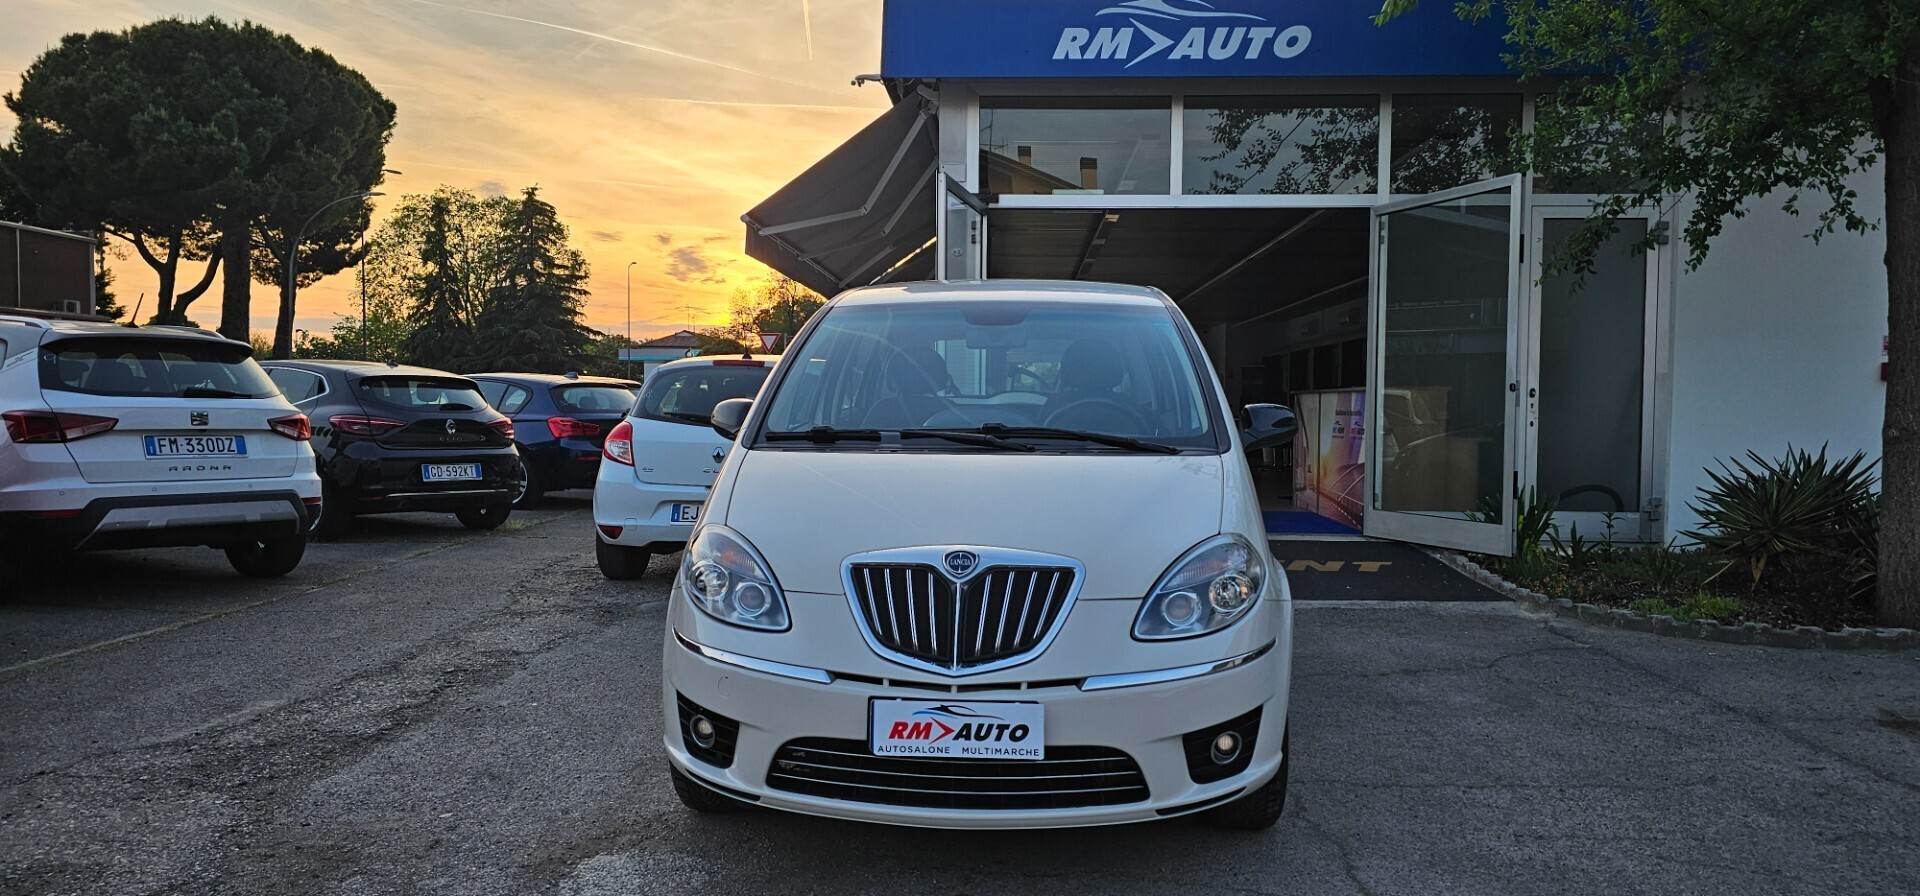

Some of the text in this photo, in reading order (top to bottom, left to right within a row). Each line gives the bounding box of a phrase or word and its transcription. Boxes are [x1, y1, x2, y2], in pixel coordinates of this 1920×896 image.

[1167, 25, 1312, 60] AUTO
[950, 558, 971, 566] LANCIA
[952, 723, 1030, 743] AUTO
[877, 745, 1040, 757] AUTOSALONE MULTIMARCHE
